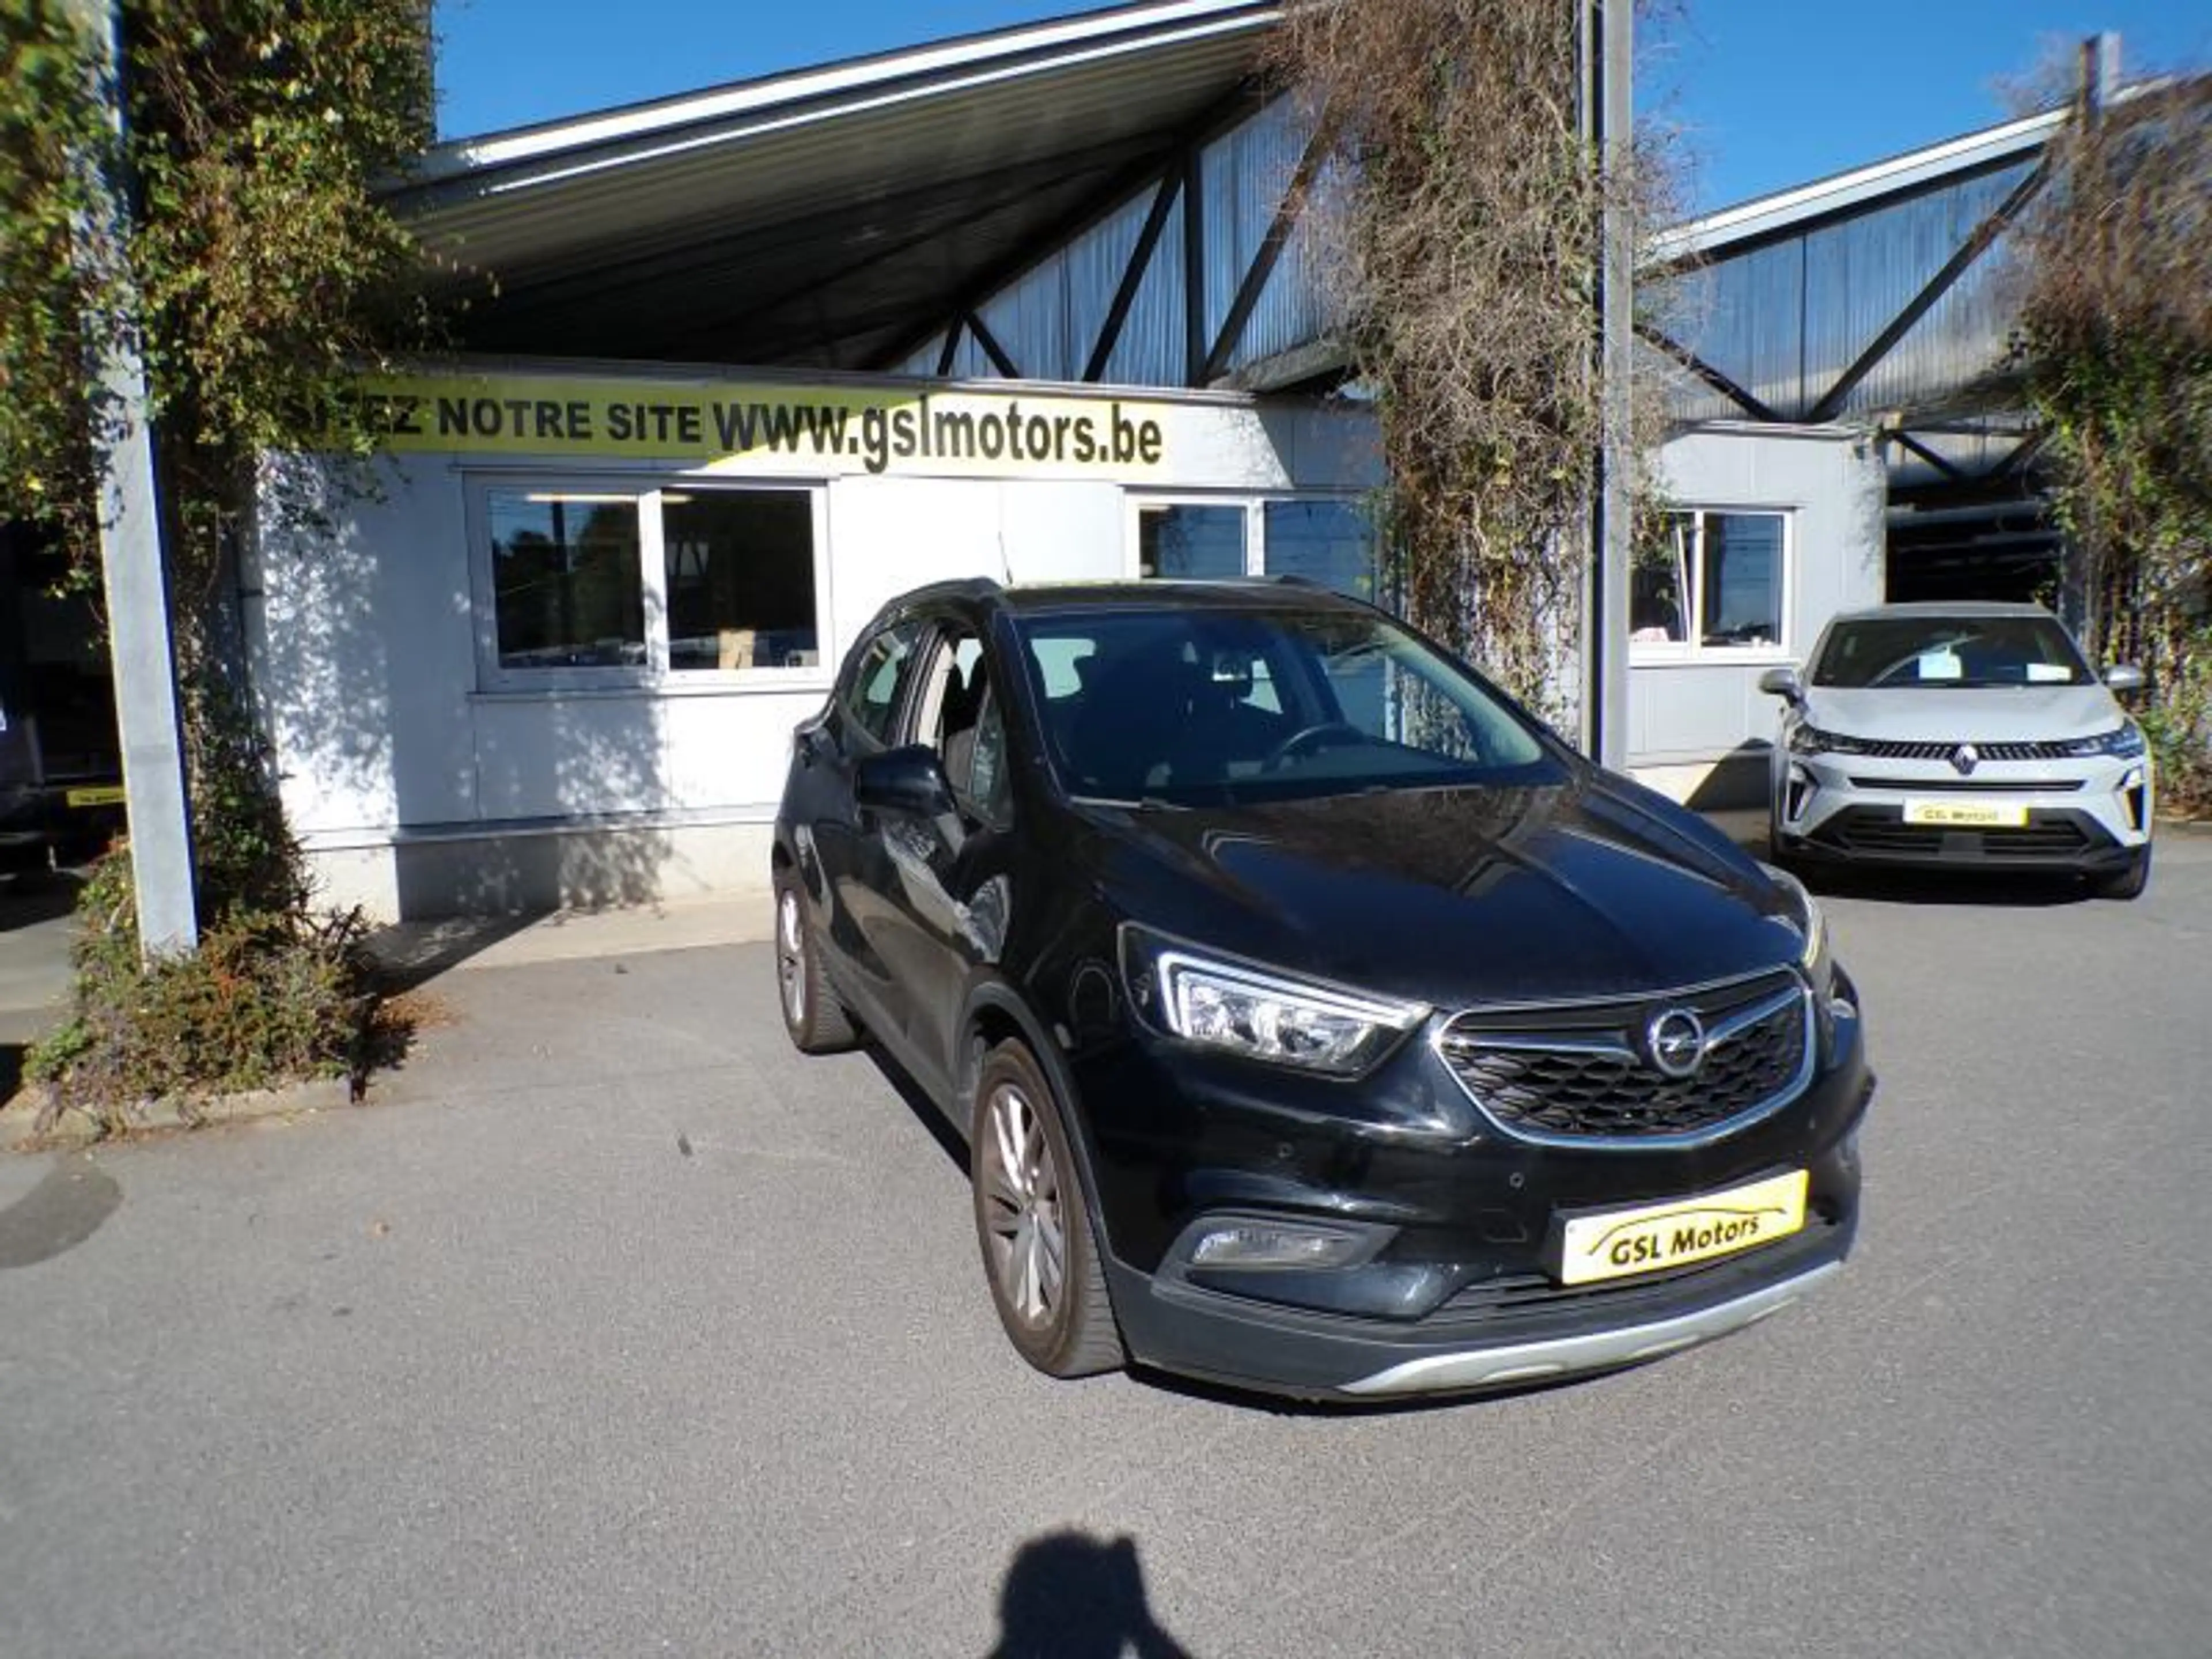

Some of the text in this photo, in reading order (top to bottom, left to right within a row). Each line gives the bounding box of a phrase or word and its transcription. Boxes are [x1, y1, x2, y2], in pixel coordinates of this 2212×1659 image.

[438, 397, 592, 439] NOTRE
[607, 404, 701, 442] SITE
[1610, 1217, 1759, 1265] GSL Motors
